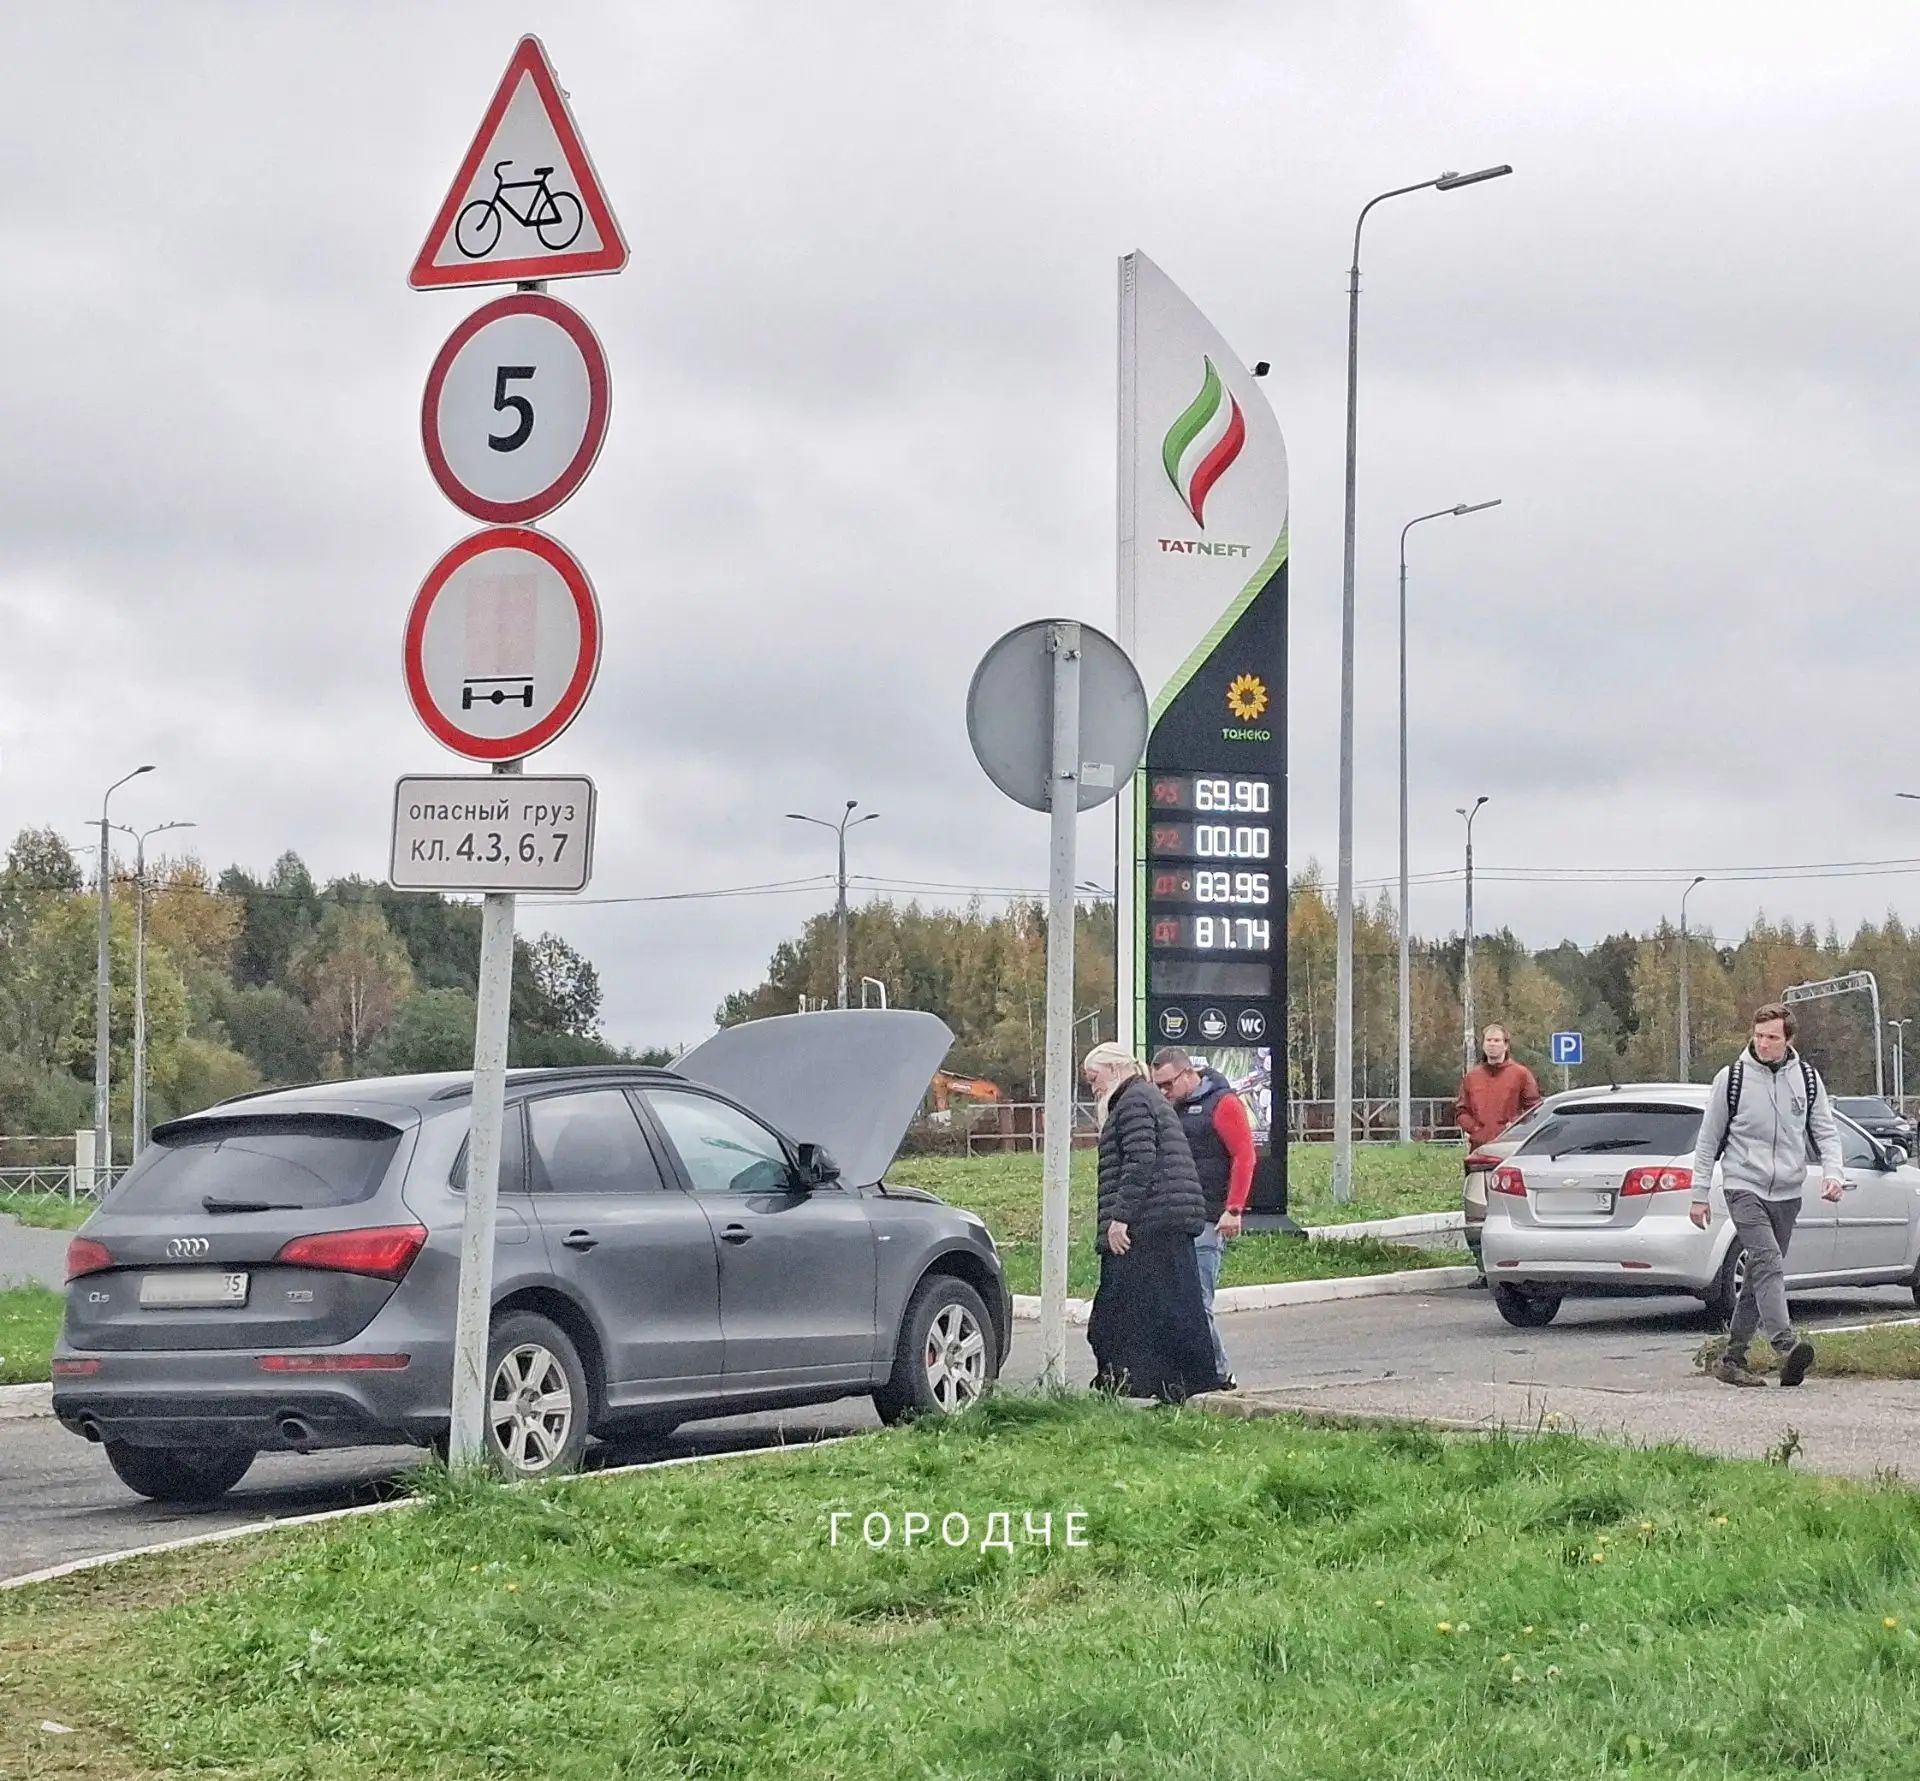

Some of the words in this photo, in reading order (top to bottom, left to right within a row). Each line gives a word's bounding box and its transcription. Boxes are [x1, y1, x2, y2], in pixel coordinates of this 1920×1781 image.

[488, 366, 537, 453] 5
[1158, 539, 1252, 558] TATNEFT
[1197, 780, 1269, 813] 69.90
[409, 799, 510, 821] опасный
[523, 804, 575, 826] груз
[1197, 825, 1270, 858] 00.00
[1197, 871, 1270, 904] 83.95
[1197, 916, 1270, 949] 81.74
[1241, 1018, 1262, 1033] WC
[1560, 1036, 1577, 1061] P
[224, 1274, 241, 1292] 35
